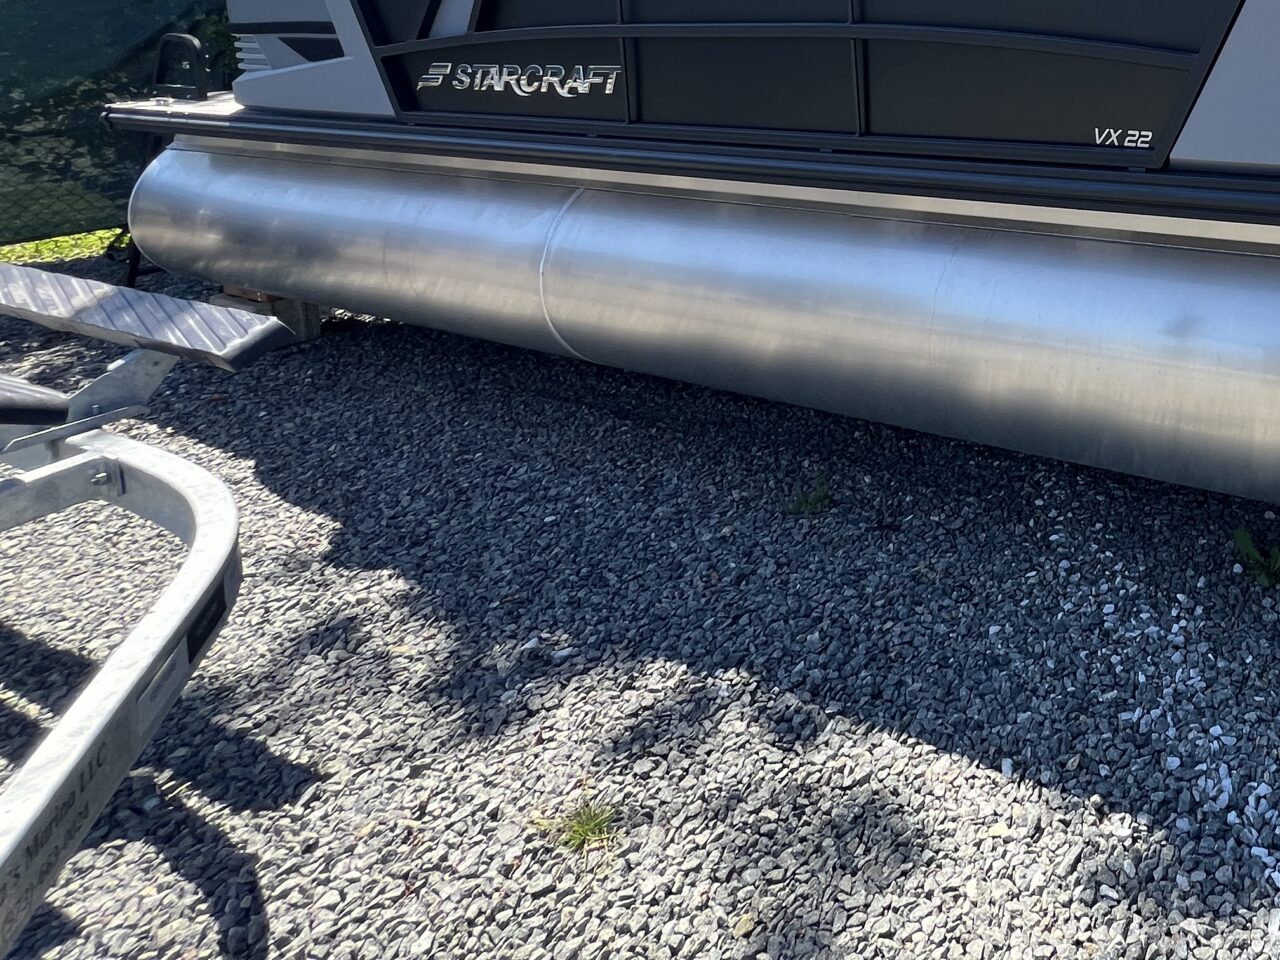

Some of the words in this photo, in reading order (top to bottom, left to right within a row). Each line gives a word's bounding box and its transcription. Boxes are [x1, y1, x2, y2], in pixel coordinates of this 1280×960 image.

[451, 63, 622, 98] STARCRAFT
[1094, 127, 1122, 146] VX
[1123, 130, 1153, 148] 22
